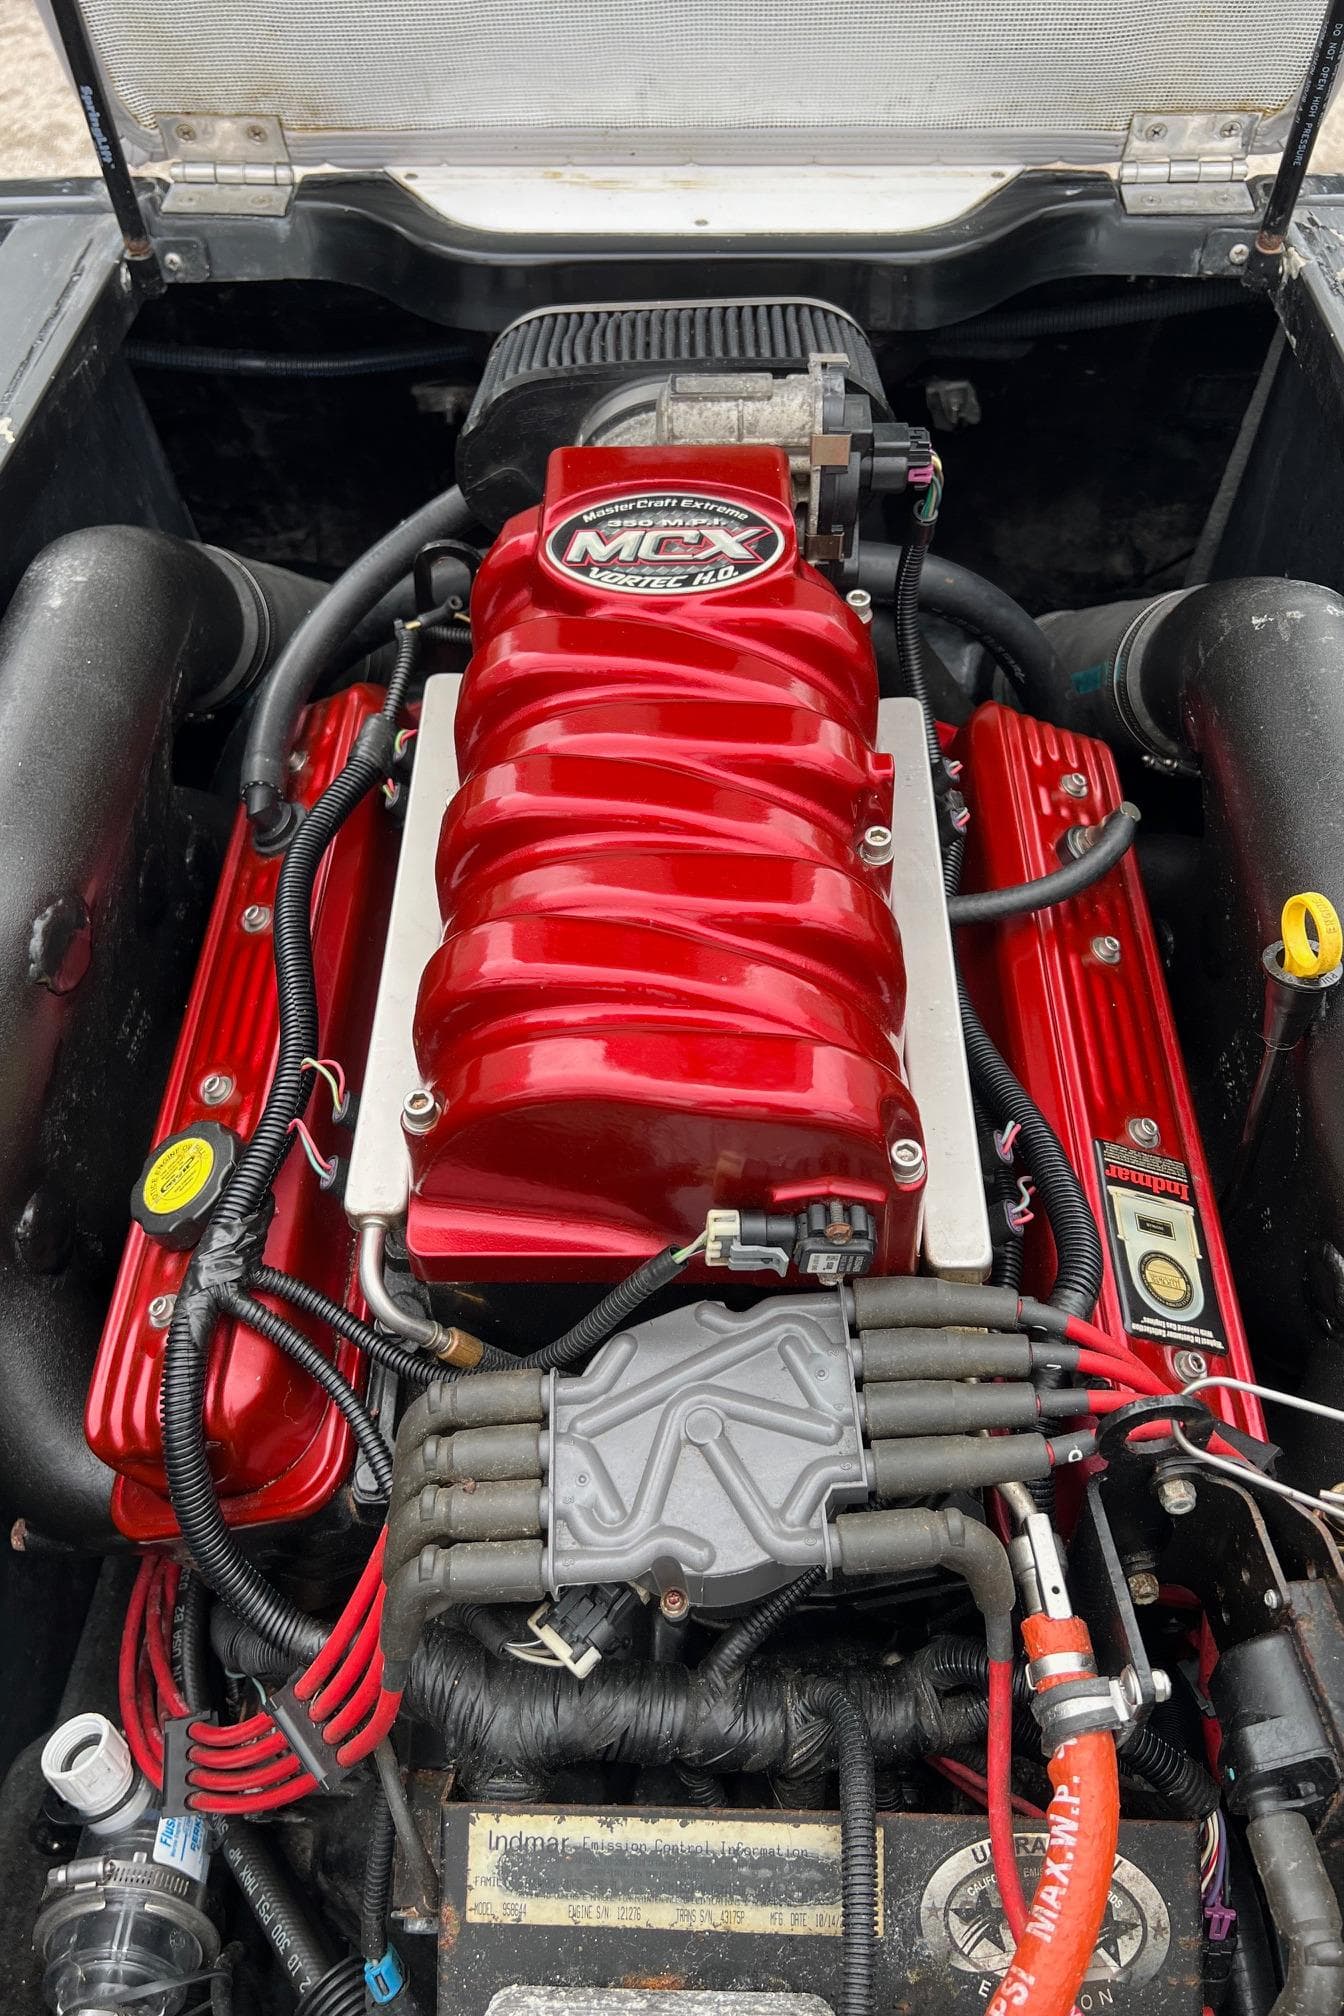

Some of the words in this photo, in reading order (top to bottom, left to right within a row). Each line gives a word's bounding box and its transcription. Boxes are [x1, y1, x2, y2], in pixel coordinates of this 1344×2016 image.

[1332, 23, 1344, 37] DO
[1325, 42, 1337, 61] NOT
[1316, 67, 1330, 91] OPEN
[1308, 96, 1321, 118] HIGH
[1292, 122, 1313, 166] PRESSURE
[582, 499, 678, 523] MasterCraft
[680, 499, 749, 521] Extreme
[607, 519, 654, 527] 350
[564, 528, 771, 563] MCX
[588, 567, 688, 588] VORTEC
[692, 565, 739, 585] H.O.
[1105, 1164, 1189, 1201] Indmar
[174, 1604, 185, 1623] B2
[172, 1629, 182, 1659] USA
[191, 1815, 202, 1851] PERK
[488, 1829, 571, 1851] Indmar
[582, 1836, 647, 1852] Emission
[654, 1838, 709, 1856] Control
[721, 1841, 808, 1857] Information
[228, 1847, 244, 1868] WP
[239, 1863, 260, 1896] MAX
[254, 1894, 273, 1924] PSI
[474, 1902, 494, 1916] MODEL
[568, 1904, 593, 1919] ENGINE
[597, 1905, 610, 1920] S/N
[617, 1906, 642, 1920] 121276
[676, 1908, 697, 1923] TRANS
[700, 1910, 713, 1923] S/N
[770, 1912, 784, 1926] MFG
[790, 1913, 807, 1927] DATE
[271, 1923, 292, 1955] 300
[299, 1975, 313, 1993] 2
